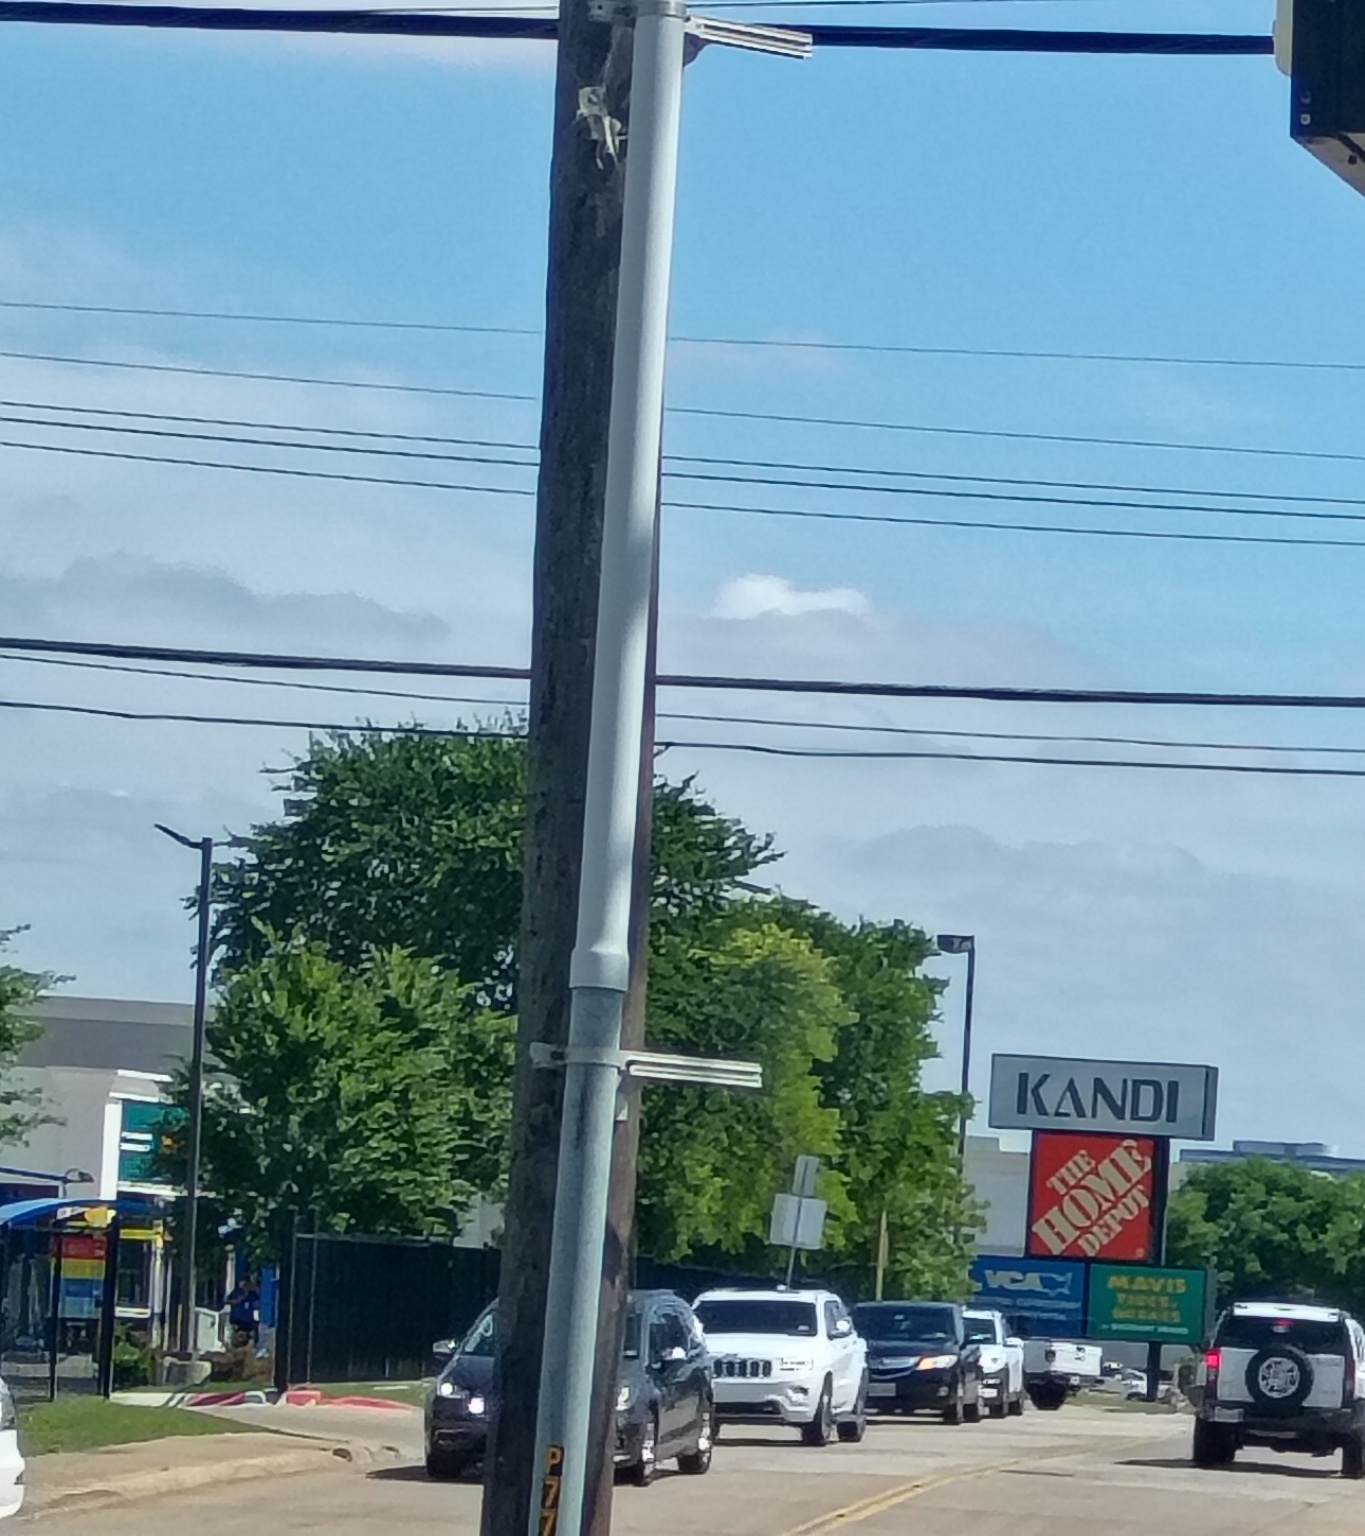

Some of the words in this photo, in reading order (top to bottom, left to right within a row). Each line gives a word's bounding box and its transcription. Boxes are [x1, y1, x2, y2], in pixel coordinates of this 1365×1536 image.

[1016, 1072, 1179, 1123] KANDI
[1045, 1149, 1096, 1195] THE
[1031, 1138, 1152, 1256] HOME
[1077, 1184, 1150, 1257] DEPOT
[984, 1269, 1043, 1291] VCA
[1106, 1276, 1187, 1294] MAVIS
